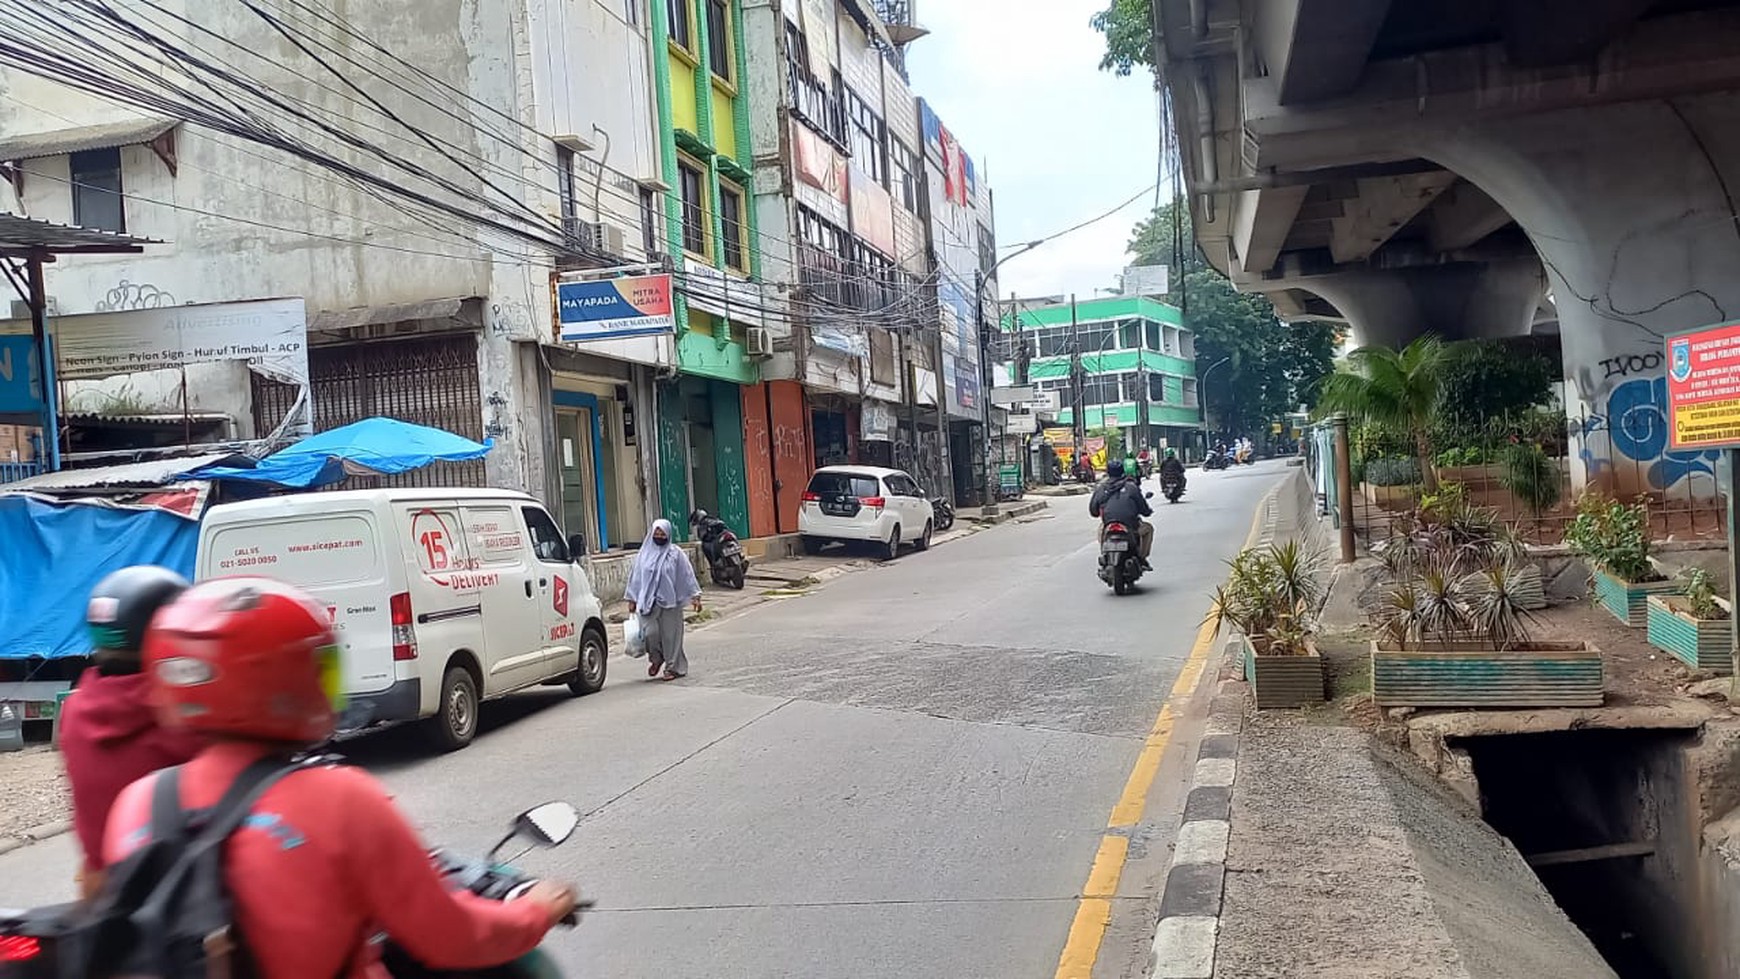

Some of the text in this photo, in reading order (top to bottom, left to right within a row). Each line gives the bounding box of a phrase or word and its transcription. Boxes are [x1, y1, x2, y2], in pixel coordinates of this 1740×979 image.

[633, 288, 661, 297] MITRA
[562, 296, 618, 309] MAYAPADA
[633, 298, 663, 306] USAHA
[66, 357, 94, 367] Neon
[98, 355, 119, 365] Sign
[129, 351, 159, 362] Pylon
[162, 349, 184, 361] Sign
[194, 345, 228, 357] Huruf
[230, 343, 269, 355] Timbul
[279, 342, 300, 352] ACP
[287, 540, 363, 553] www.sicepat.com
[420, 531, 447, 569] 15
